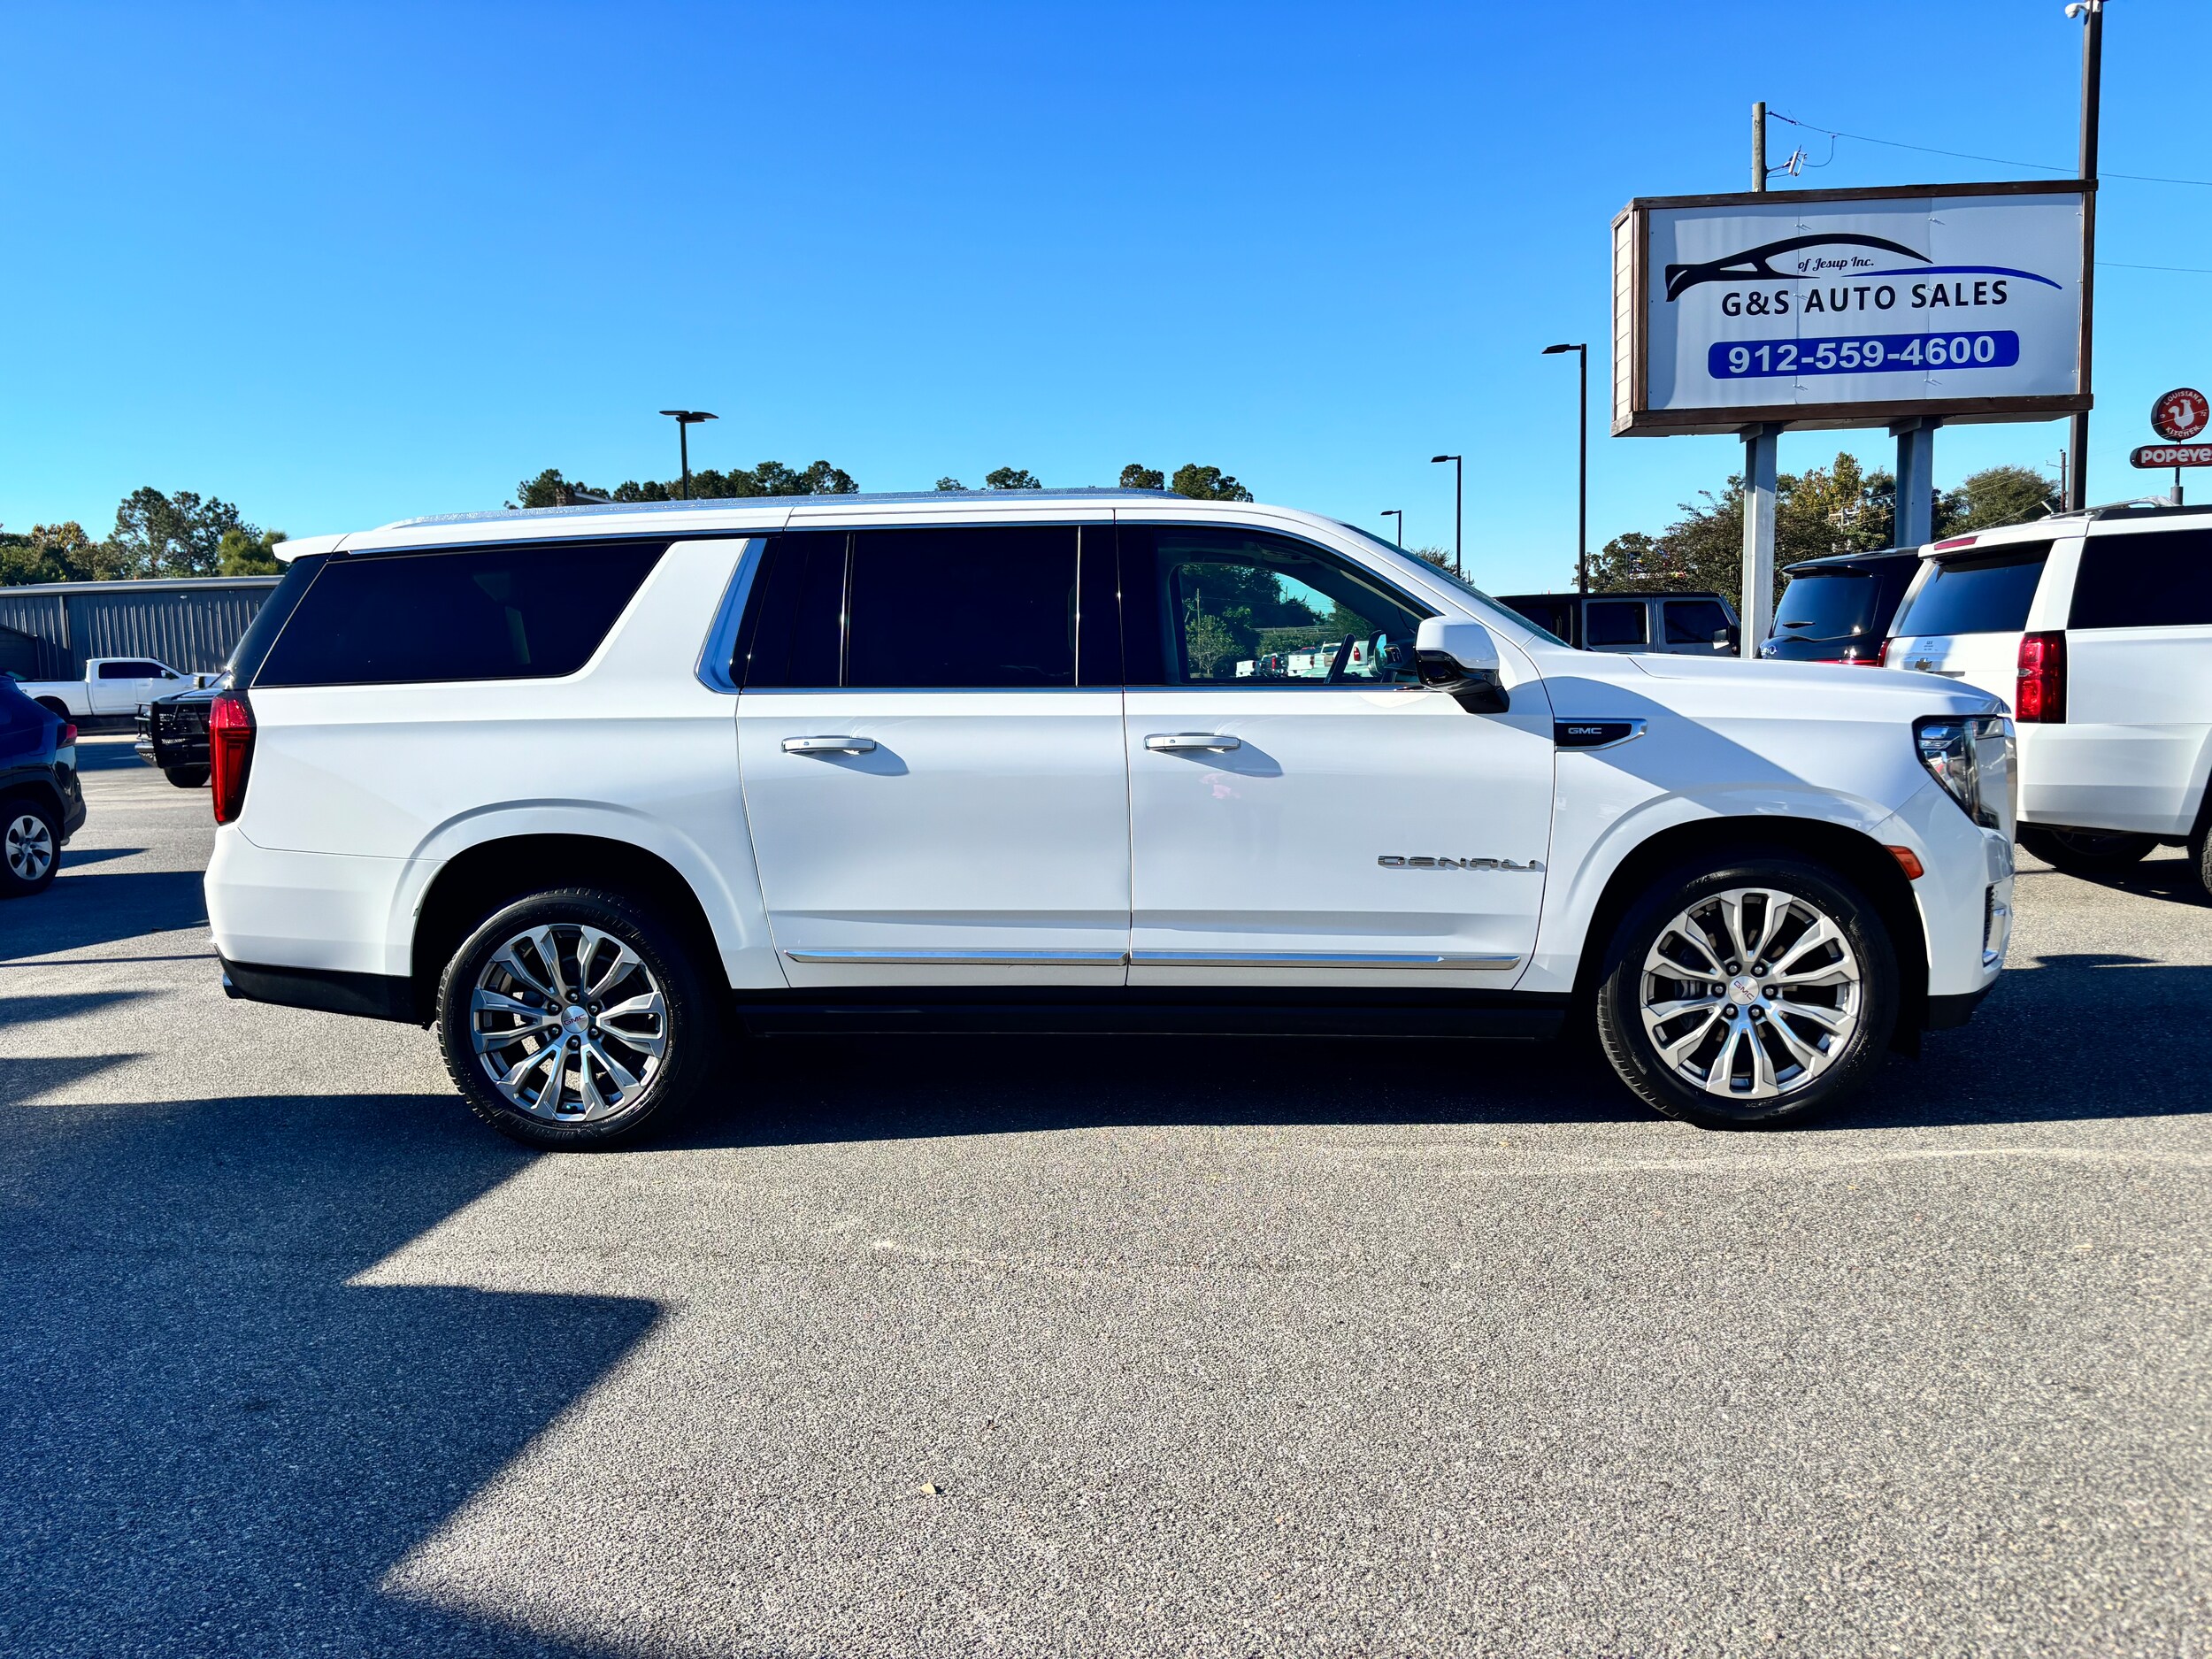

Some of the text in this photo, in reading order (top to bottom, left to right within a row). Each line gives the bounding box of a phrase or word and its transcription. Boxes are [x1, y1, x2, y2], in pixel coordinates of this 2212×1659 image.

[1798, 257, 1874, 272] of Jesup Inc.
[1722, 280, 2007, 316] G&S AUTO SALES
[1728, 335, 1995, 373] 912-559-4600
[2163, 391, 2202, 405] LOUISIANA
[1378, 855, 1536, 870] DENALI
[1734, 980, 1755, 1001] GMC
[564, 1014, 586, 1025] GMC
